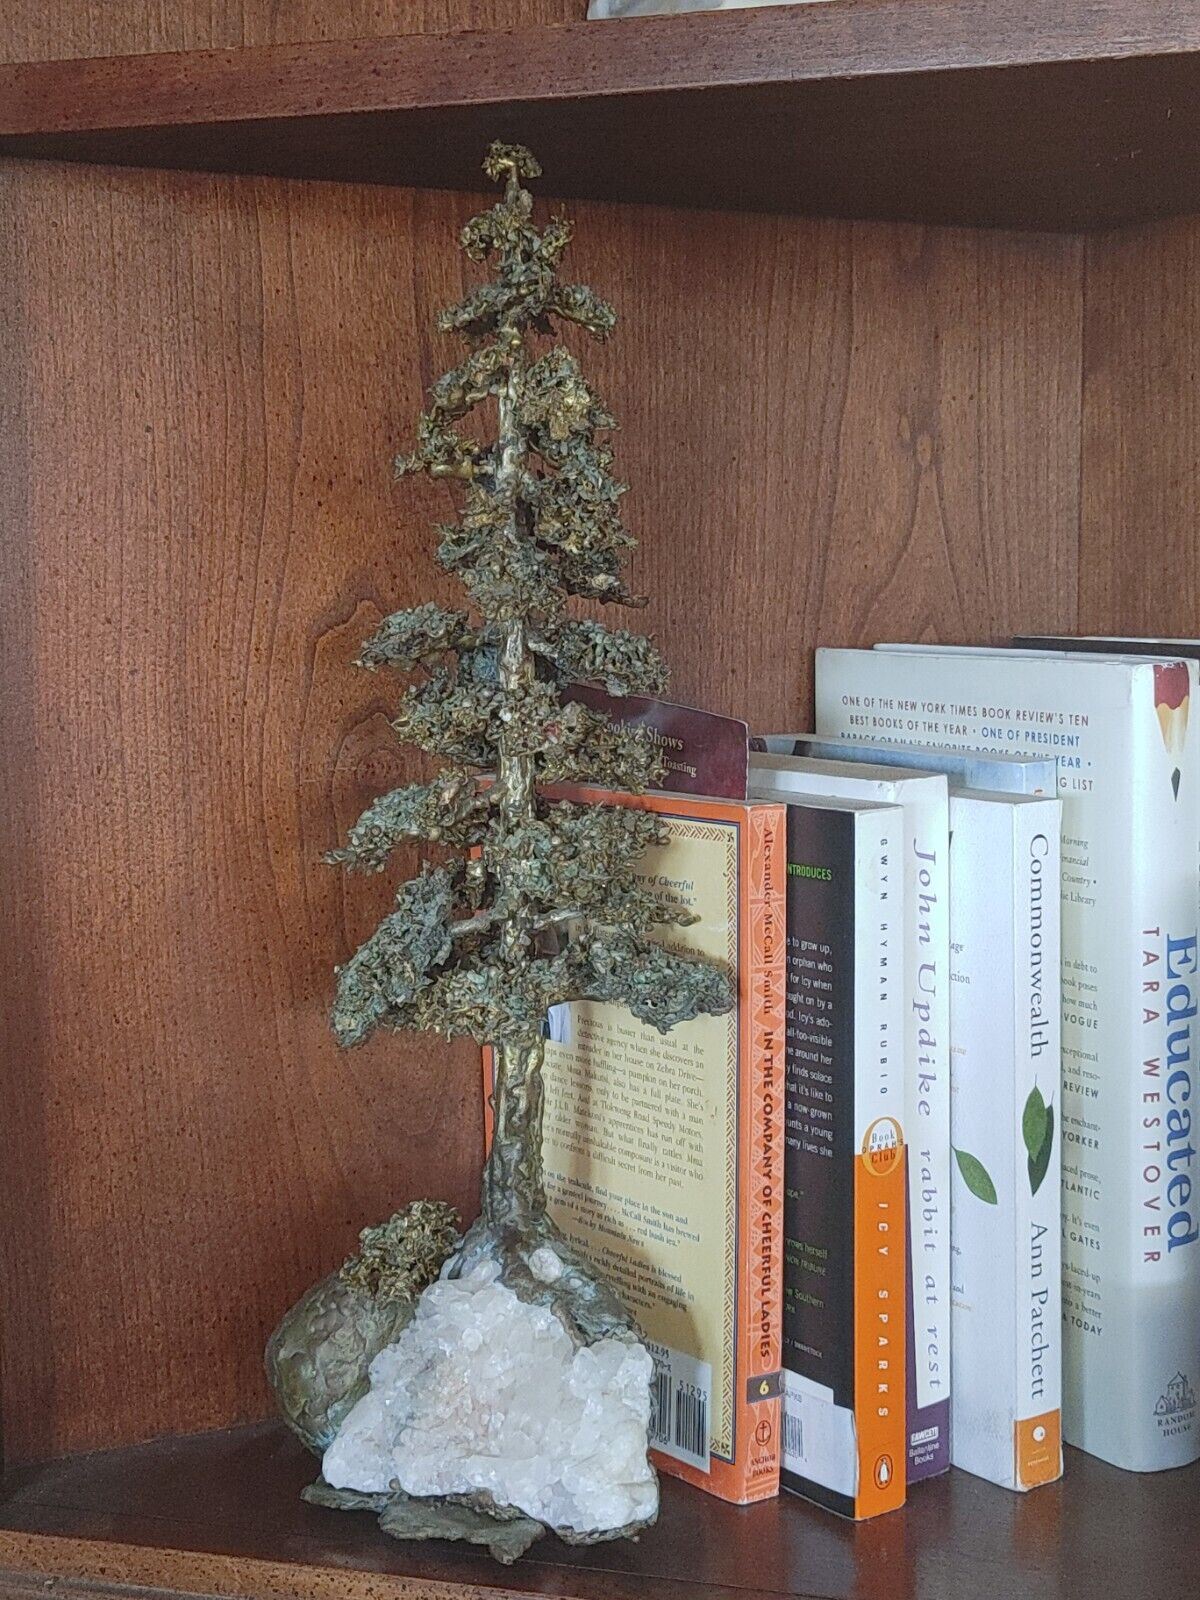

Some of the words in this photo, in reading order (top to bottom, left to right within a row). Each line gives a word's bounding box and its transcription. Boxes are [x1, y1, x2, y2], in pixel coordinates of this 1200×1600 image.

[842, 696, 860, 707] ONE
[863, 697, 875, 708] OF
[878, 699, 894, 710] THE
[898, 700, 917, 712] NEW
[921, 702, 946, 715] YORK
[950, 704, 977, 717] TIMES
[982, 707, 1010, 720] BOOK
[1016, 710, 1064, 725] REVIEW'S
[1069, 714, 1089, 727] TEN
[646, 726, 684, 751] Shows
[849, 715, 869, 726] BEST
[873, 716, 903, 730] BOOKS
[907, 719, 919, 731] OF
[923, 721, 939, 733] THE
[943, 723, 967, 736] YEAR
[981, 727, 1002, 739] ONE
[1007, 729, 1021, 741] OF
[1025, 731, 1080, 747] PRESIDENT
[662, 756, 697, 778] Toasting
[1055, 757, 1081, 769] YEAR
[1073, 779, 1093, 791] LIST
[763, 829, 773, 908] Alexander
[879, 838, 888, 900] GWYN
[648, 875, 658, 887] of
[659, 876, 694, 891] Cheerful
[1061, 871, 1091, 888] Country
[655, 891, 663, 901] of
[665, 893, 678, 904] the
[913, 837, 937, 945] John
[1070, 891, 1096, 907] Library
[763, 914, 773, 964] McCall
[792, 937, 799, 947] to
[800, 940, 817, 952] grow
[819, 944, 832, 956] up,
[1030, 834, 1049, 1058] Commonwealth
[697, 947, 705, 957] to
[879, 923, 888, 1001] HYMAN
[792, 957, 816, 971] orphan
[817, 962, 833, 973] who
[1064, 957, 1071, 968] in
[1073, 958, 1088, 971] debt
[1090, 962, 1098, 974] to
[790, 973, 800, 984] for
[813, 978, 833, 991] when
[1142, 927, 1160, 1025] TARA
[763, 970, 773, 1014] Smith
[1078, 981, 1098, 993] poses
[806, 997, 815, 1006] on
[817, 998, 826, 1010] by
[827, 1001, 833, 1010] a
[1078, 997, 1098, 1011] much
[1064, 1012, 1098, 1030] VOGUE
[763, 1032, 774, 1051] IN
[912, 961, 937, 1116] Updike
[630, 1042, 648, 1055] when
[650, 1046, 661, 1058] she
[663, 1050, 694, 1066] discovers
[694, 1044, 704, 1055] the
[795, 1047, 818, 1062] around
[820, 1053, 833, 1065] her
[879, 1023, 888, 1095] RUBIO
[612, 1051, 622, 1061] her
[625, 1053, 643, 1067] house
[657, 1062, 675, 1075] Zebra
[763, 1055, 774, 1088] THE
[1068, 1065, 1081, 1076] and
[628, 1070, 656, 1084] pumpkin
[659, 1079, 667, 1088] on
[669, 1079, 680, 1091] her
[792, 1063, 808, 1078] finds
[810, 1070, 832, 1084] solace
[629, 1082, 639, 1093] has
[798, 1083, 809, 1096] it's
[810, 1087, 823, 1101] like
[825, 1092, 833, 1103] to
[1063, 1080, 1099, 1099] REVIEW
[1166, 928, 1200, 1254] Educated
[612, 1090, 619, 1099] to
[621, 1092, 629, 1103] be
[665, 1107, 680, 1119] with
[634, 1110, 650, 1123] Road
[653, 1116, 675, 1133] Speedy
[661, 1134, 672, 1144] run
[675, 1137, 686, 1148] off
[763, 1093, 774, 1180] COMPANY
[804, 1123, 809, 1132] a
[810, 1126, 833, 1141] young
[872, 1129, 895, 1144] Book
[1062, 1130, 1099, 1149] YORKER
[638, 1138, 658, 1155] finally
[819, 1144, 833, 1158] she
[872, 1149, 896, 1164] Club
[1142, 1058, 1161, 1264] WESTOVER
[618, 1161, 636, 1173] secret
[639, 1165, 654, 1178] from
[655, 1170, 666, 1182] her
[689, 1168, 704, 1181] who
[762, 1186, 773, 1207] OF
[919, 1150, 938, 1252] rabbit
[625, 1197, 641, 1209] place
[650, 1205, 661, 1216] the
[662, 1211, 674, 1220] sun
[675, 1216, 688, 1225] and
[878, 1203, 888, 1257] ICY
[1031, 1222, 1048, 1278] Ann
[1070, 1231, 1101, 1250] GATES
[762, 1212, 772, 1296] CHEERFUL
[658, 1267, 682, 1282] blessed
[675, 1286, 687, 1298] life
[688, 1291, 695, 1302] in
[924, 1275, 938, 1305] at
[1075, 1302, 1080, 1310] a
[1081, 1301, 1102, 1319] better
[760, 1301, 771, 1358] LADIES
[1071, 1316, 1102, 1336] TODAY
[878, 1289, 888, 1417] SPARKS
[1031, 1287, 1050, 1401] Patchett
[927, 1325, 941, 1389] rest
[679, 1380, 708, 1402] 51295
[760, 1380, 769, 1395] 6
[914, 1453, 934, 1466] Books
